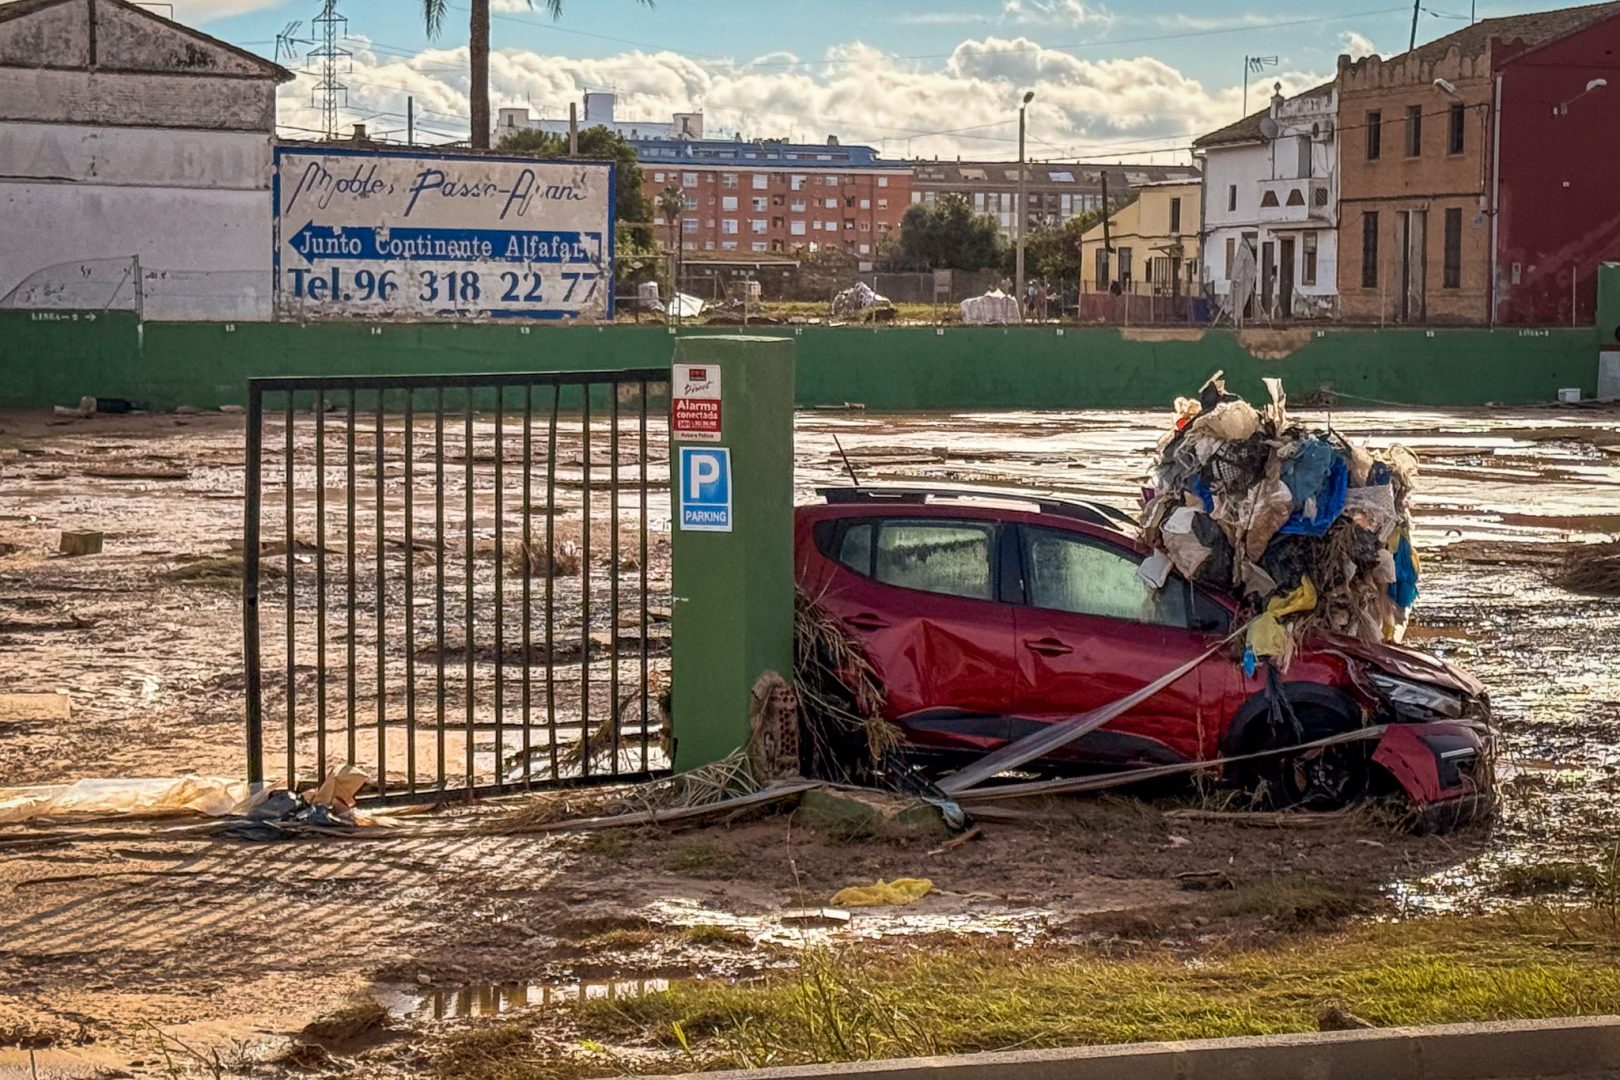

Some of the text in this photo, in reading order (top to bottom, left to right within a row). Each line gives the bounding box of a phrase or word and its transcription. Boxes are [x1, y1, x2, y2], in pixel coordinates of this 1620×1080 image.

[300, 231, 584, 258] Junto Continente Alfafar
[418, 270, 481, 302] 318
[500, 271, 543, 302] 22
[560, 272, 601, 303] 77
[676, 400, 718, 411] Alarma
[676, 411, 718, 420] conectada
[690, 454, 720, 499] P
[685, 510, 727, 523] PARKING
